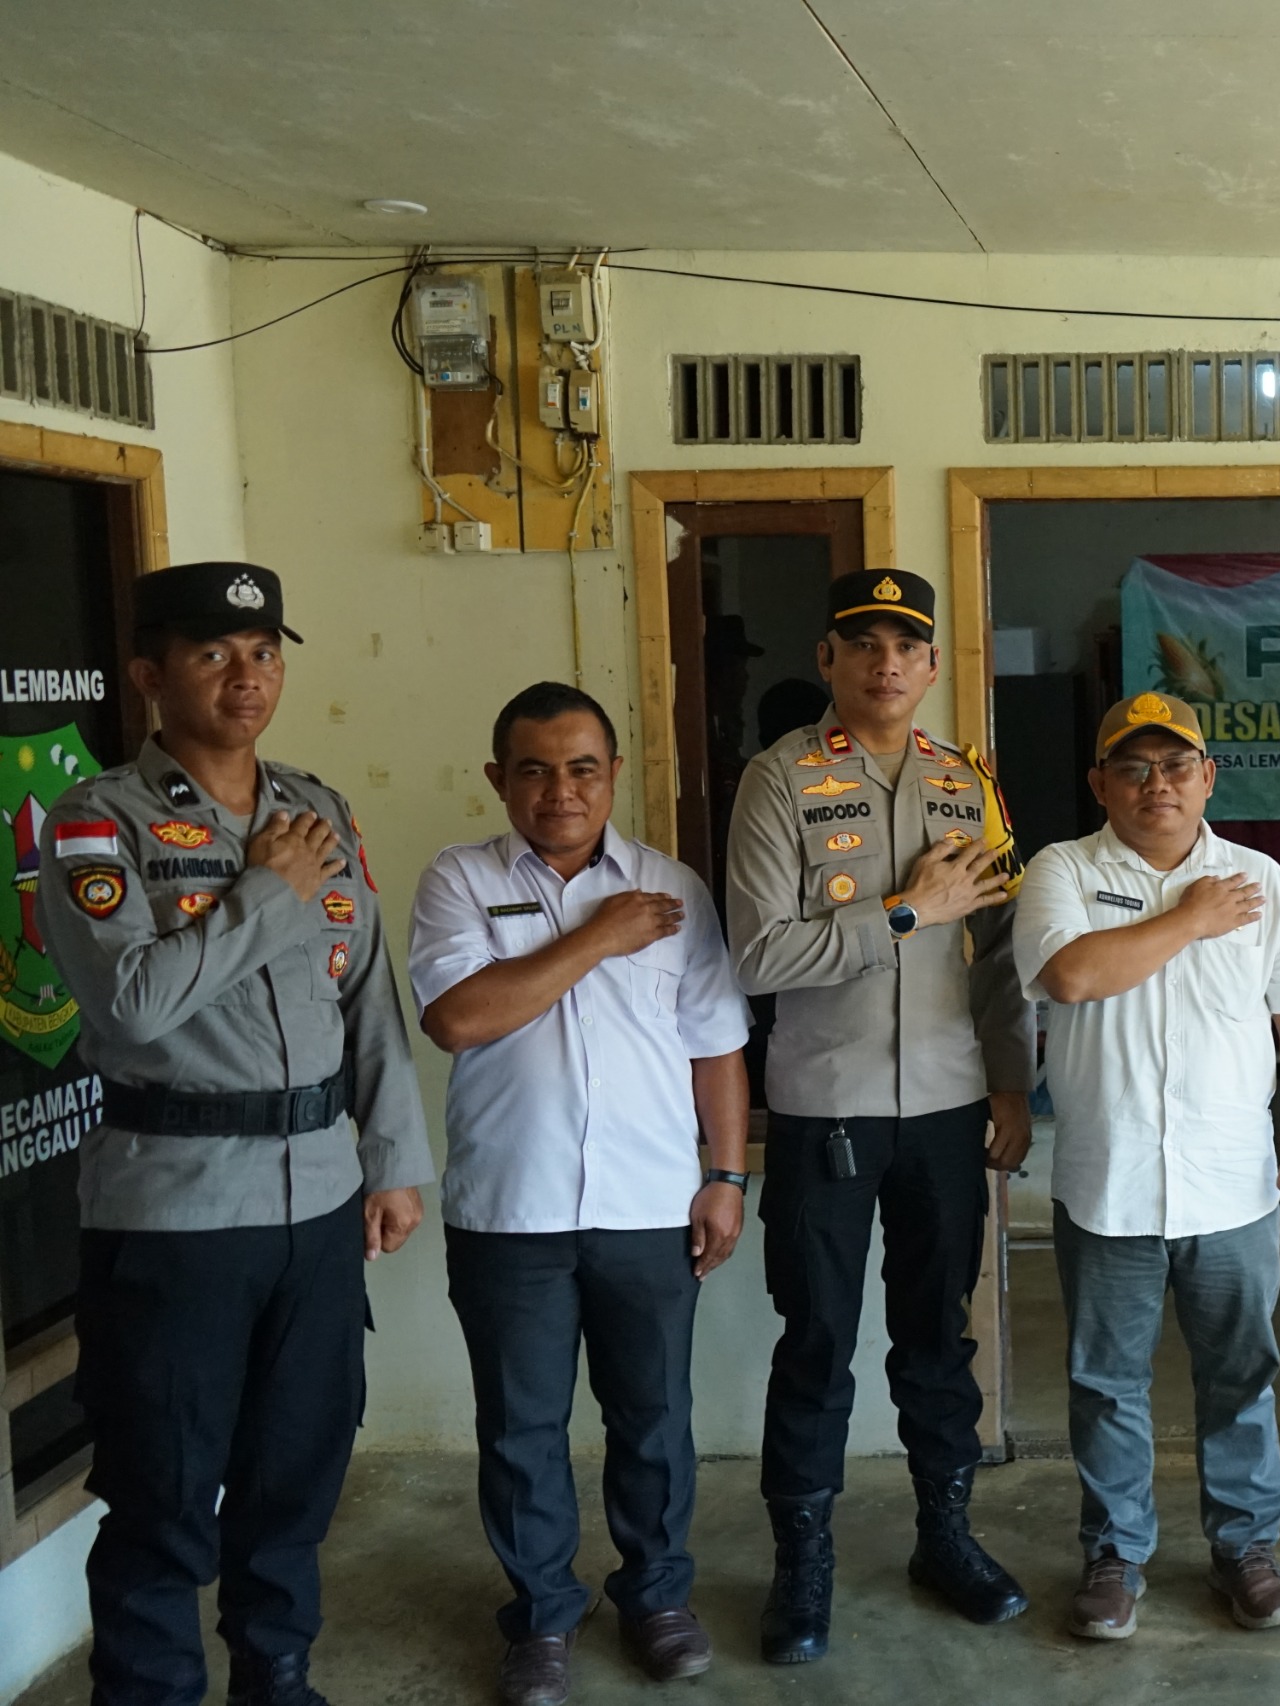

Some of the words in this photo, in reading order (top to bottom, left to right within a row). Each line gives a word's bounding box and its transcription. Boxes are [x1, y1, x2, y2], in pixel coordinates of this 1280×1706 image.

[553, 323, 582, 335] PLN
[1, 669, 105, 702] LEMBANG
[1208, 754, 1244, 768] ESA
[803, 801, 871, 825] WIDODO
[926, 801, 982, 823] POLRI
[0, 1073, 104, 1138] ECAMATA
